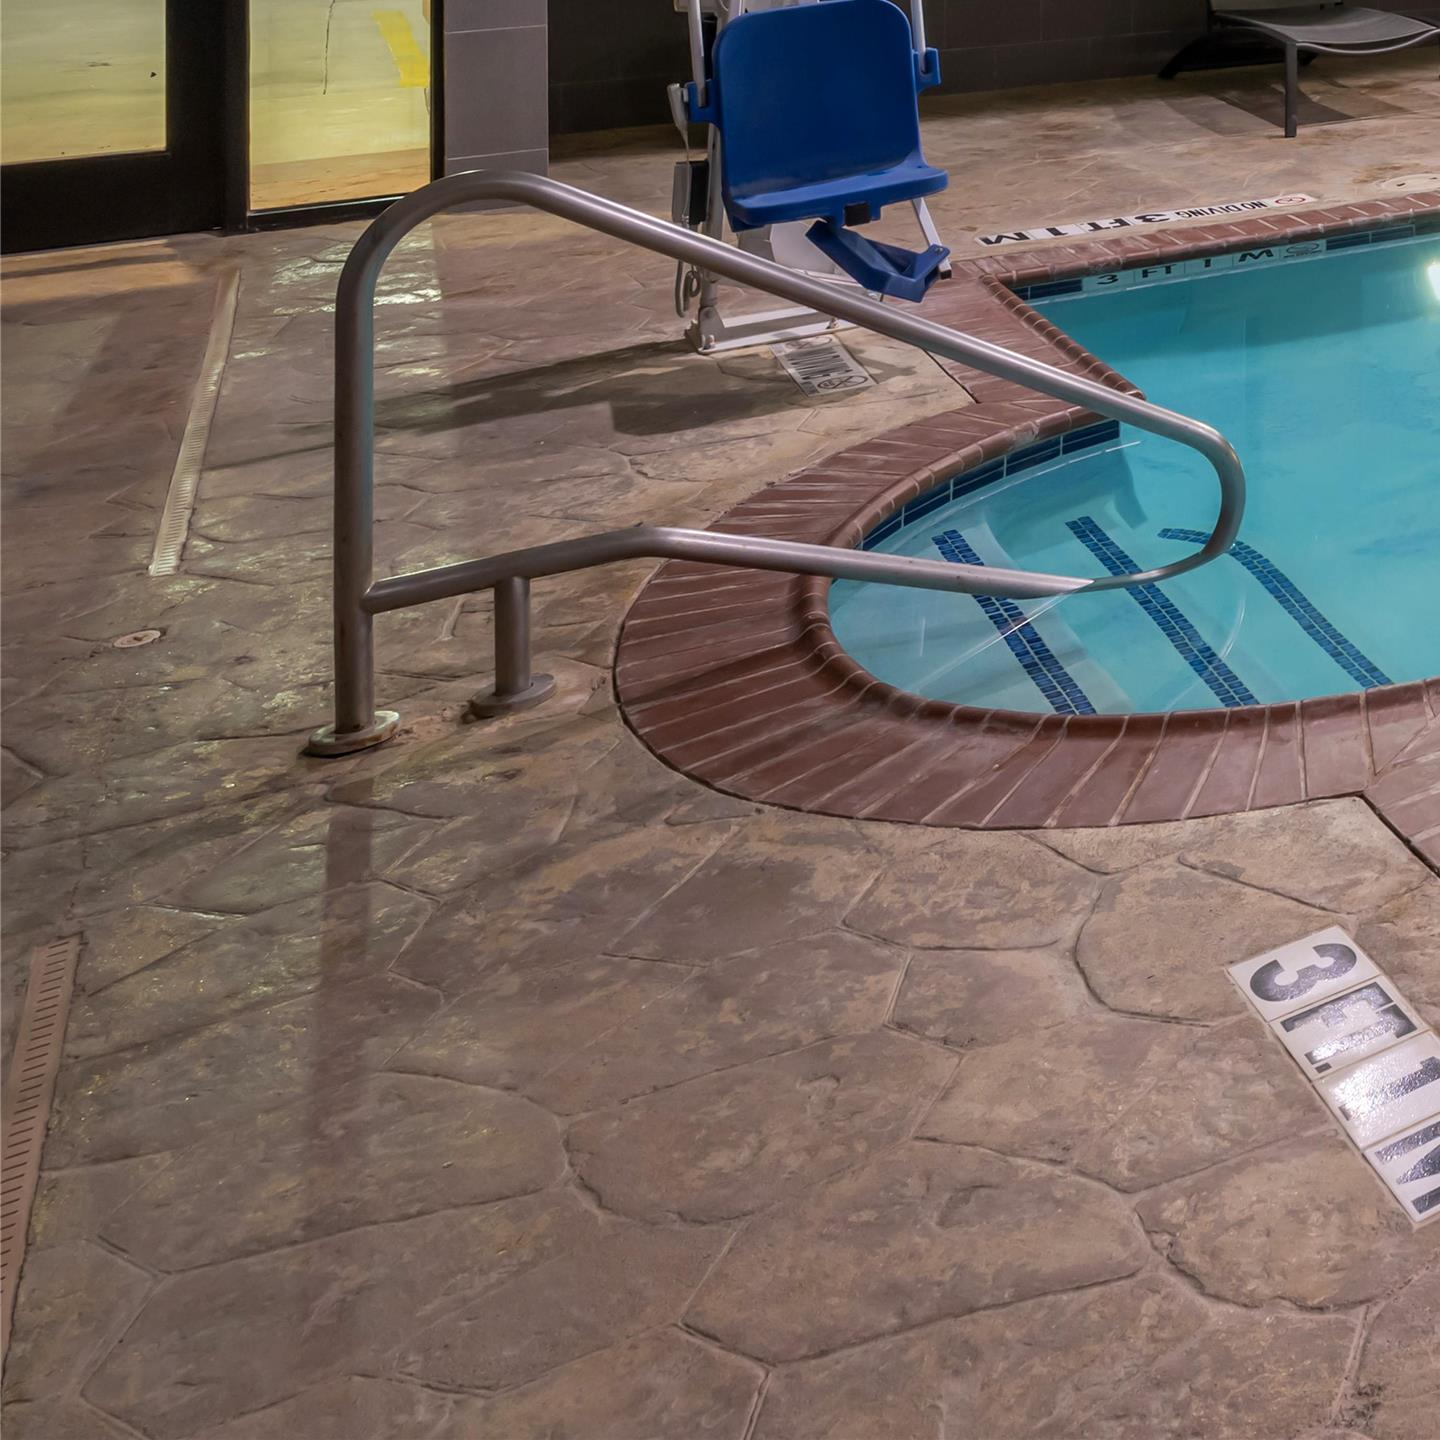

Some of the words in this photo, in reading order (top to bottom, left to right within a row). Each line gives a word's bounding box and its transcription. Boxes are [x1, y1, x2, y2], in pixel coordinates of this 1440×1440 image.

[1245, 200, 1268, 210] NO
[1174, 204, 1240, 219] DIVING
[1134, 213, 1171, 223] 3
[1045, 227, 1069, 237] 1
[979, 231, 1031, 246] M
[1250, 942, 1357, 1003] 3
